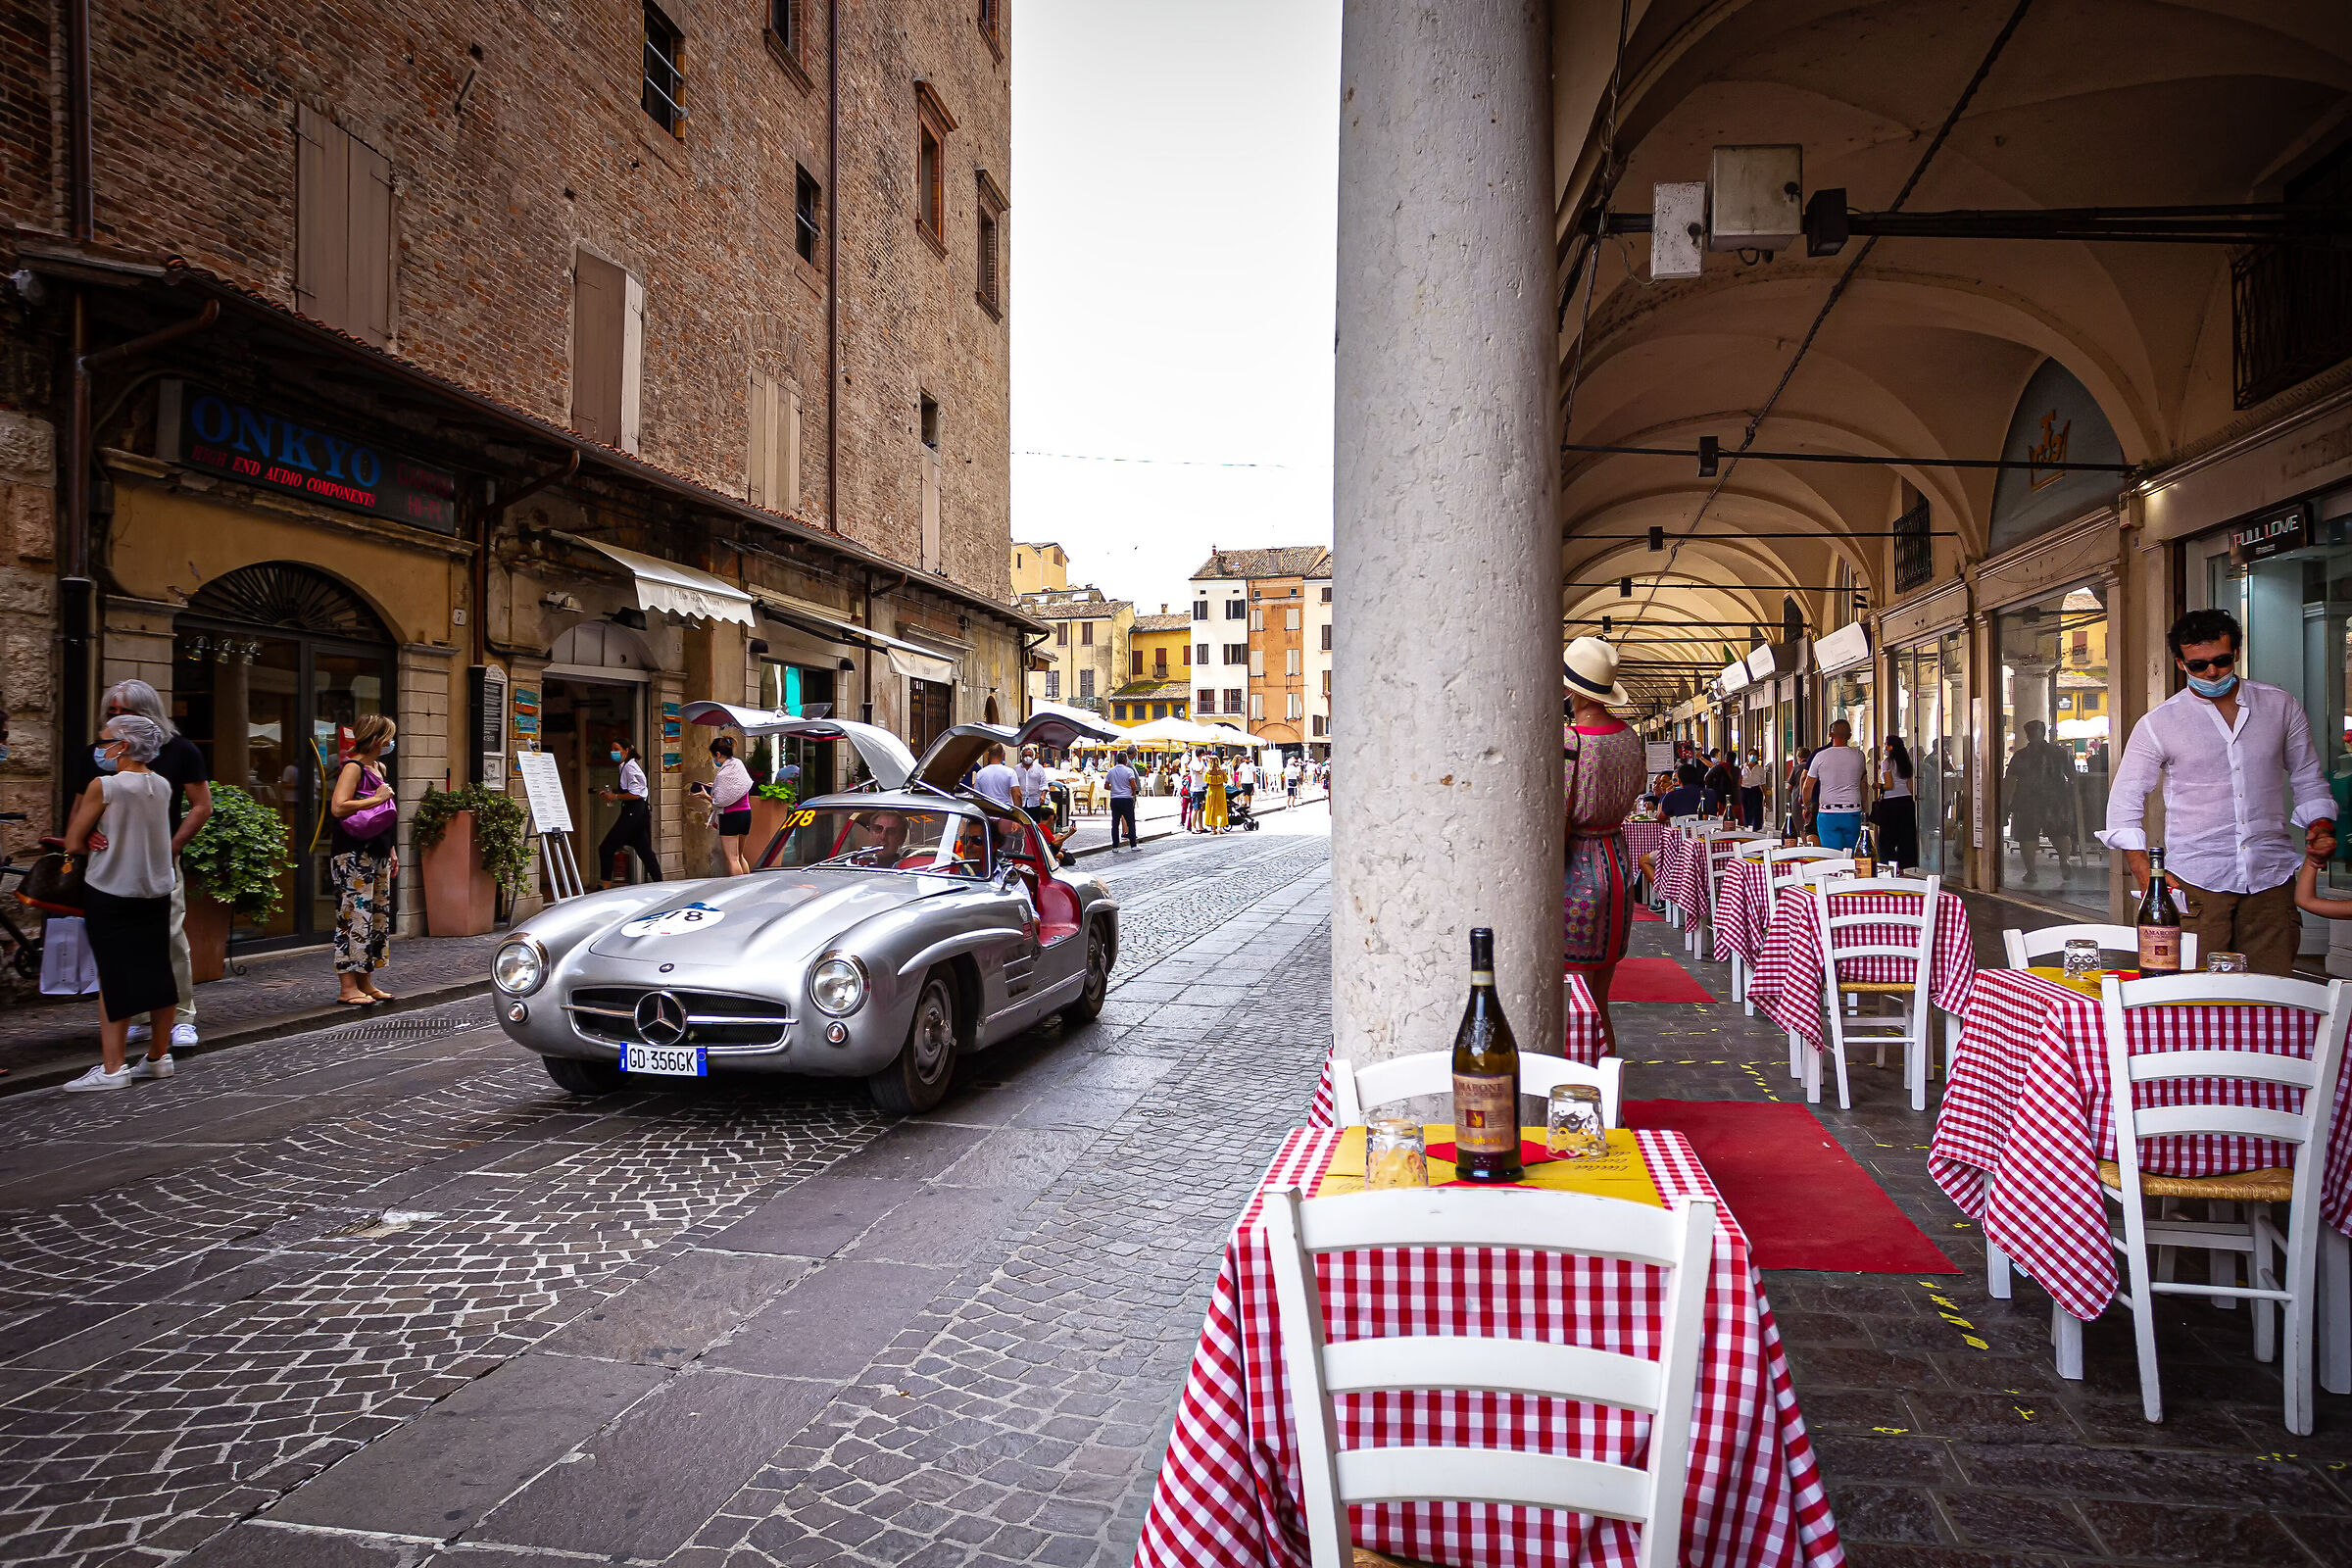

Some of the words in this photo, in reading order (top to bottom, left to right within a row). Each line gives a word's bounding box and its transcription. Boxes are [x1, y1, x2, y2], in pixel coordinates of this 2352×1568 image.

[191, 396, 380, 486] ONKYO
[191, 445, 227, 467] HIGH
[232, 455, 261, 475] END
[265, 466, 302, 488] AUDIO
[307, 477, 376, 508] COMPONENTS
[408, 493, 441, 522] HI-FI
[457, 612, 462, 622] 7
